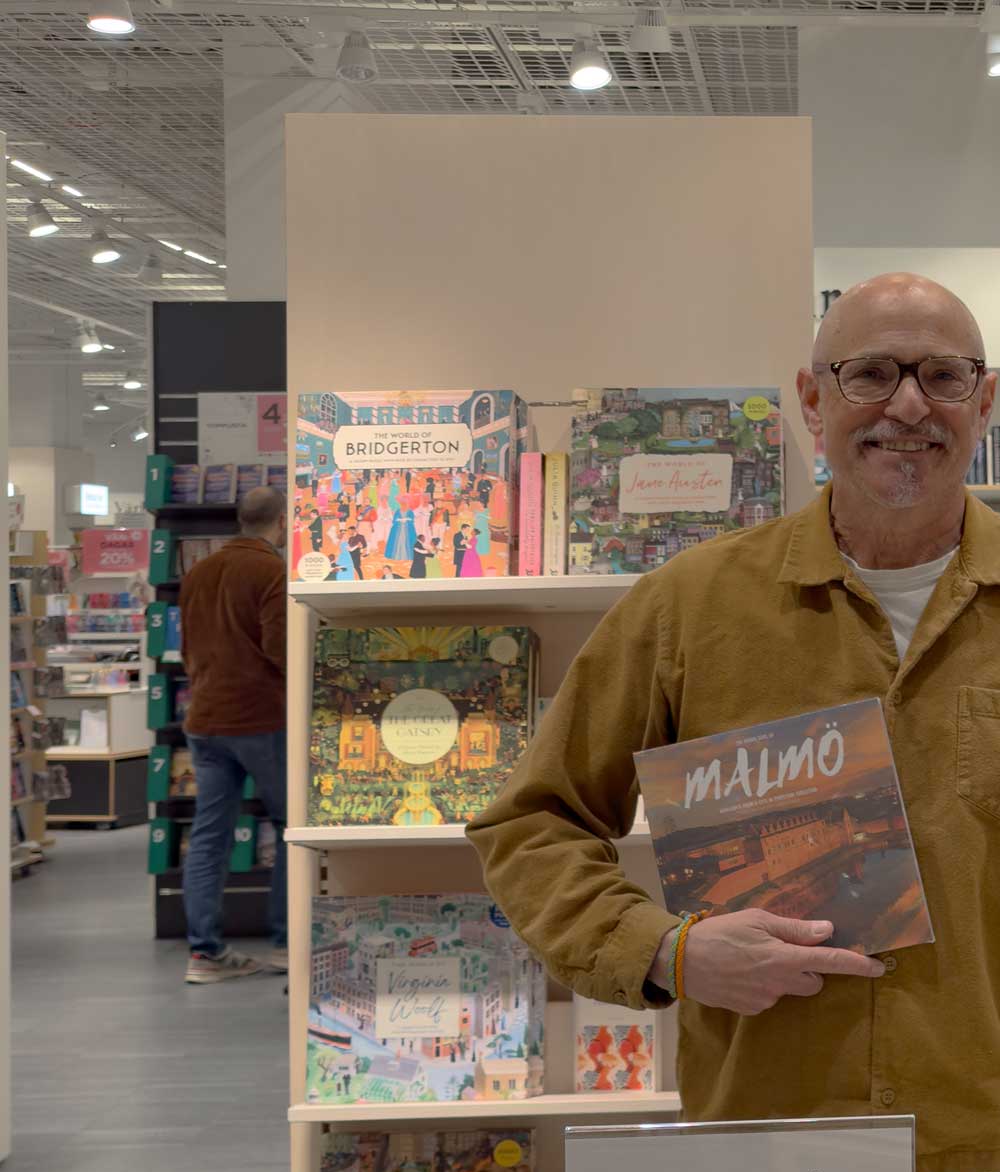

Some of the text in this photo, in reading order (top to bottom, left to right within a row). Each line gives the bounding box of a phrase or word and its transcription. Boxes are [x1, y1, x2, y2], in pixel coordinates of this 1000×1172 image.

[261, 402, 281, 425] 4
[421, 431, 432, 439] OF
[345, 440, 460, 456] BRIDGERTON
[150, 468, 159, 481] 1
[624, 469, 722, 493] Jane Austen
[153, 540, 166, 554] 2
[151, 614, 163, 627] 3
[151, 687, 163, 699] 5
[153, 759, 166, 772] 7
[684, 721, 845, 809] MALMÖ
[153, 829, 165, 842] 9
